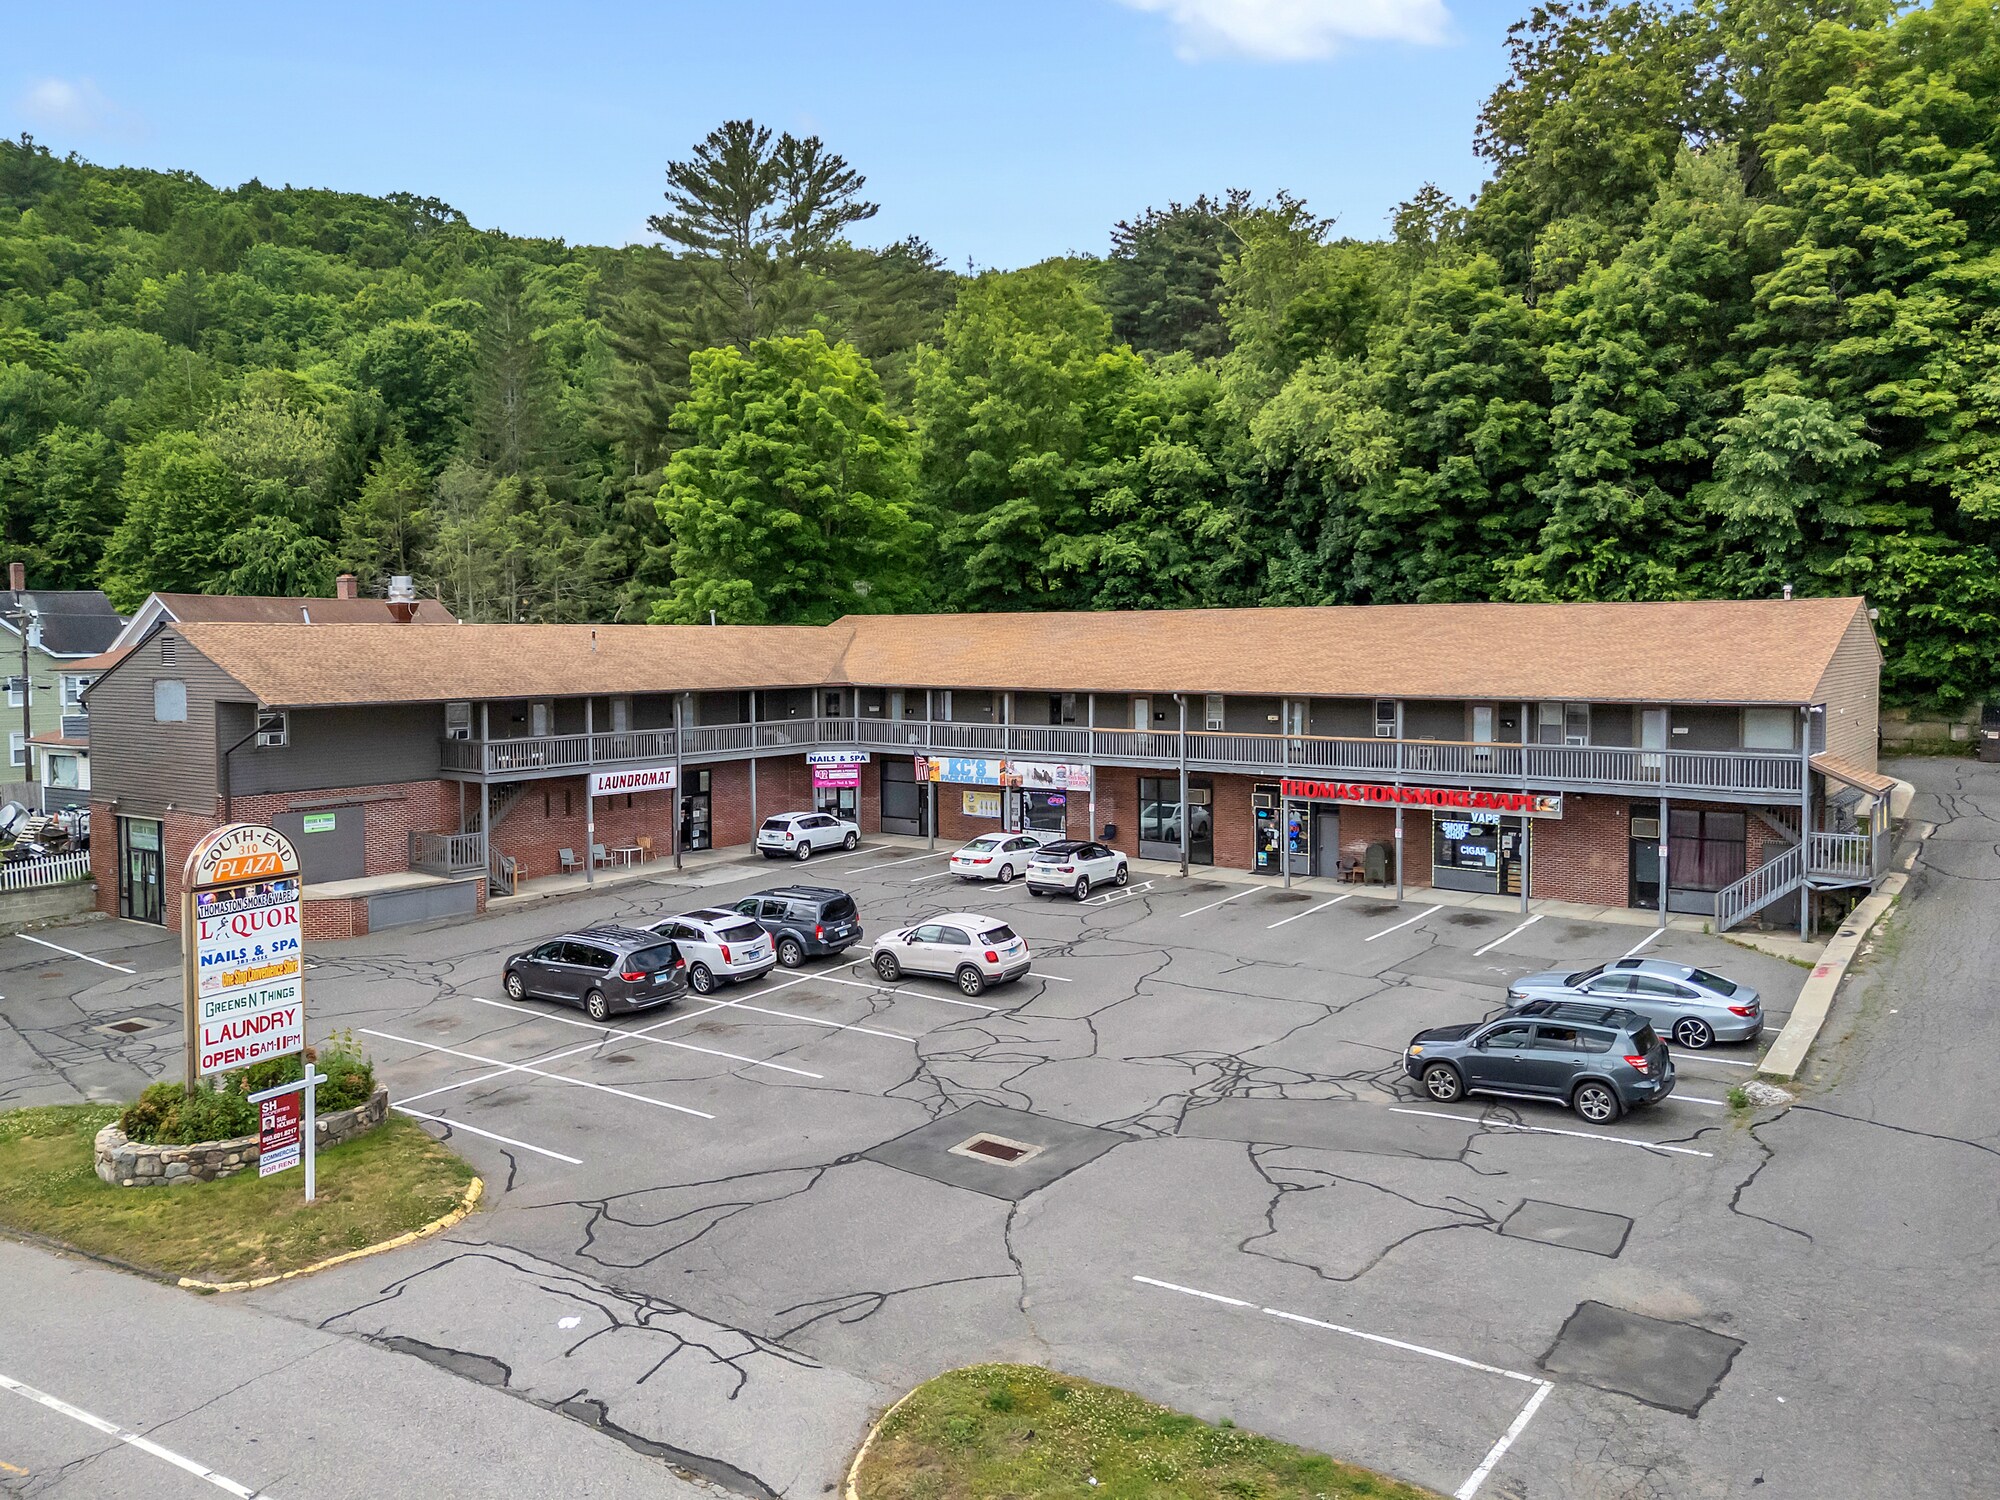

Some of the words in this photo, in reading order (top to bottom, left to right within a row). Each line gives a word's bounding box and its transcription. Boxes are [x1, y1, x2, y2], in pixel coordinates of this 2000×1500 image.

[809, 755, 836, 763] NAILS
[850, 754, 867, 762] SPA
[948, 758, 987, 777] KC'S
[598, 771, 671, 791] LAUNDROMAT
[1442, 822, 1469, 832] SMOKE
[1471, 812, 1500, 825] VAPE
[1445, 830, 1466, 840] SHOP
[203, 829, 292, 872] SOUTH-END
[239, 843, 259, 855] 310
[1460, 846, 1487, 856] CIGAR
[216, 855, 277, 879] PLAZA
[200, 898, 243, 918] THOMASTON
[244, 893, 266, 909] SMOKE
[201, 948, 247, 967] NAILS
[254, 944, 265, 956] &
[271, 938, 299, 953] SPA
[222, 971, 235, 988] One
[234, 969, 248, 987] Stop
[247, 962, 284, 982] Convenience
[283, 958, 299, 975] Store
[248, 992, 257, 1009] N
[205, 1008, 296, 1047] LAUNDRY
[261, 1100, 277, 1113] SH
[262, 1146, 297, 1163] COMMERCIAL
[261, 1164, 277, 1175] FOR
[278, 1158, 298, 1170] RENT
